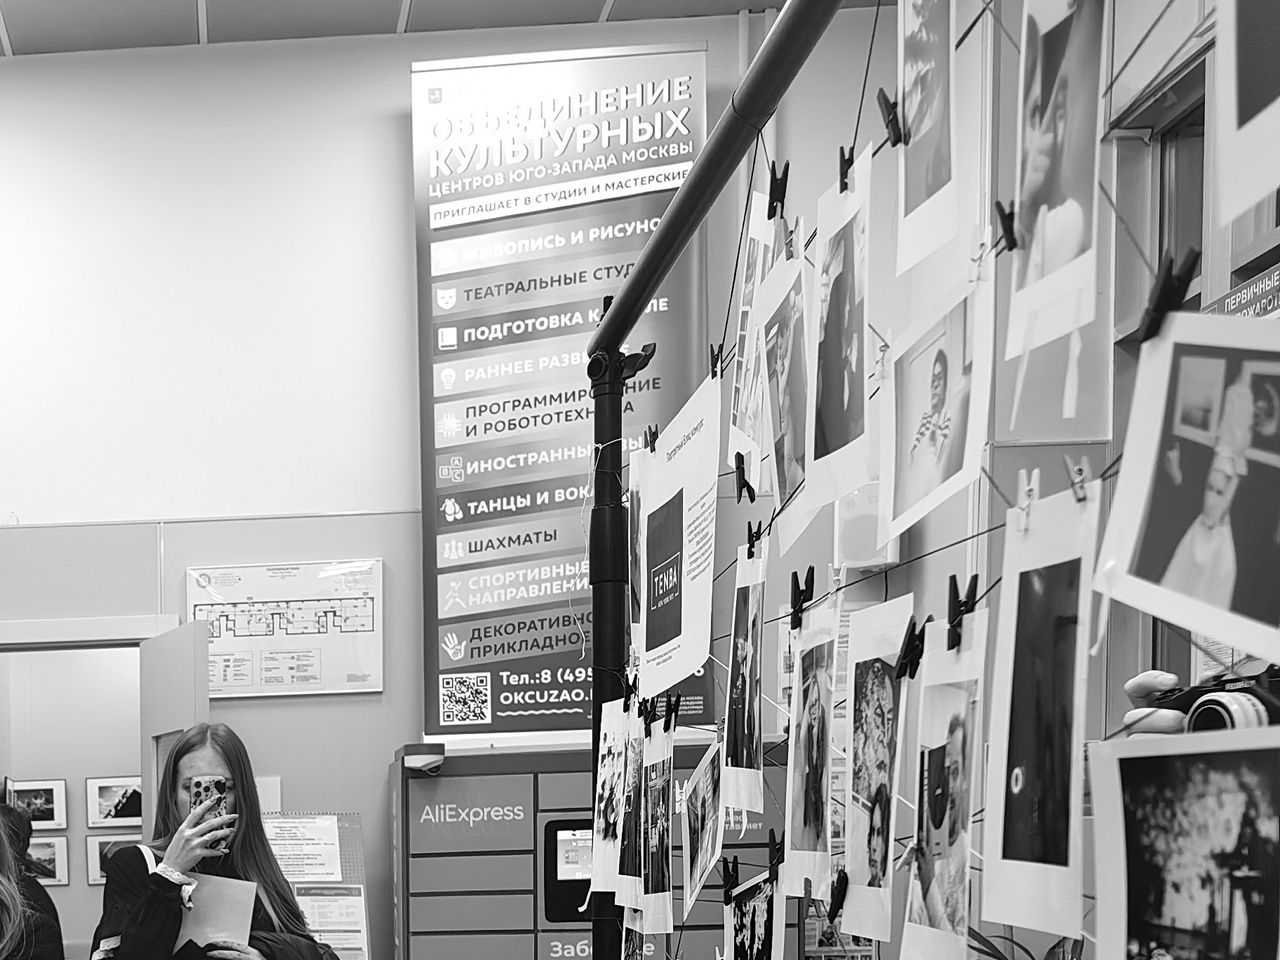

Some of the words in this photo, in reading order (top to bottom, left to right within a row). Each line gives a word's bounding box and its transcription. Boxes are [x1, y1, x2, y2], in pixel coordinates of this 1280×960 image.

[429, 106, 691, 179] КУЛЬТУРНЫХ
[428, 172, 505, 198] ЦЕНТРОВ
[509, 153, 618, 183] ЮГО-ЗАПАДА
[622, 140, 693, 164] МОСКВЫ
[433, 198, 519, 221] ПРИГЛАШАЕТ
[524, 196, 531, 205] В
[535, 187, 587, 204] СТУДИИ
[592, 184, 600, 194] И
[605, 169, 689, 192] МАСТЕРСКИЕ
[570, 230, 584, 245] И
[588, 217, 661, 242] РИСУНО
[463, 270, 588, 301] ТЕАТРАЛЬНЫЕ
[593, 262, 636, 280] СТУД
[1224, 270, 1280, 314] ПЕРВИЧНЫЕ
[463, 310, 584, 342] ПОДГОТОВКА
[588, 308, 600, 323] К
[464, 359, 534, 382] РАННЕЕ
[466, 424, 478, 438] И
[466, 444, 593, 475] ИНОСТРАННЫ
[467, 493, 531, 515] ТАНЦЫ
[536, 491, 549, 505] И
[554, 485, 594, 503] ВОК
[468, 529, 558, 553] ШАХМАТЫ
[468, 561, 590, 590] СПОРТИВНЫЕ
[654, 564, 677, 597] TENBA
[468, 576, 593, 606] НАПРАВЛЕНИ
[470, 630, 591, 659] ПРИКЛАДНОЕ
[499, 688, 593, 705] OKCUZAO.
[420, 803, 525, 829] AliExpress
